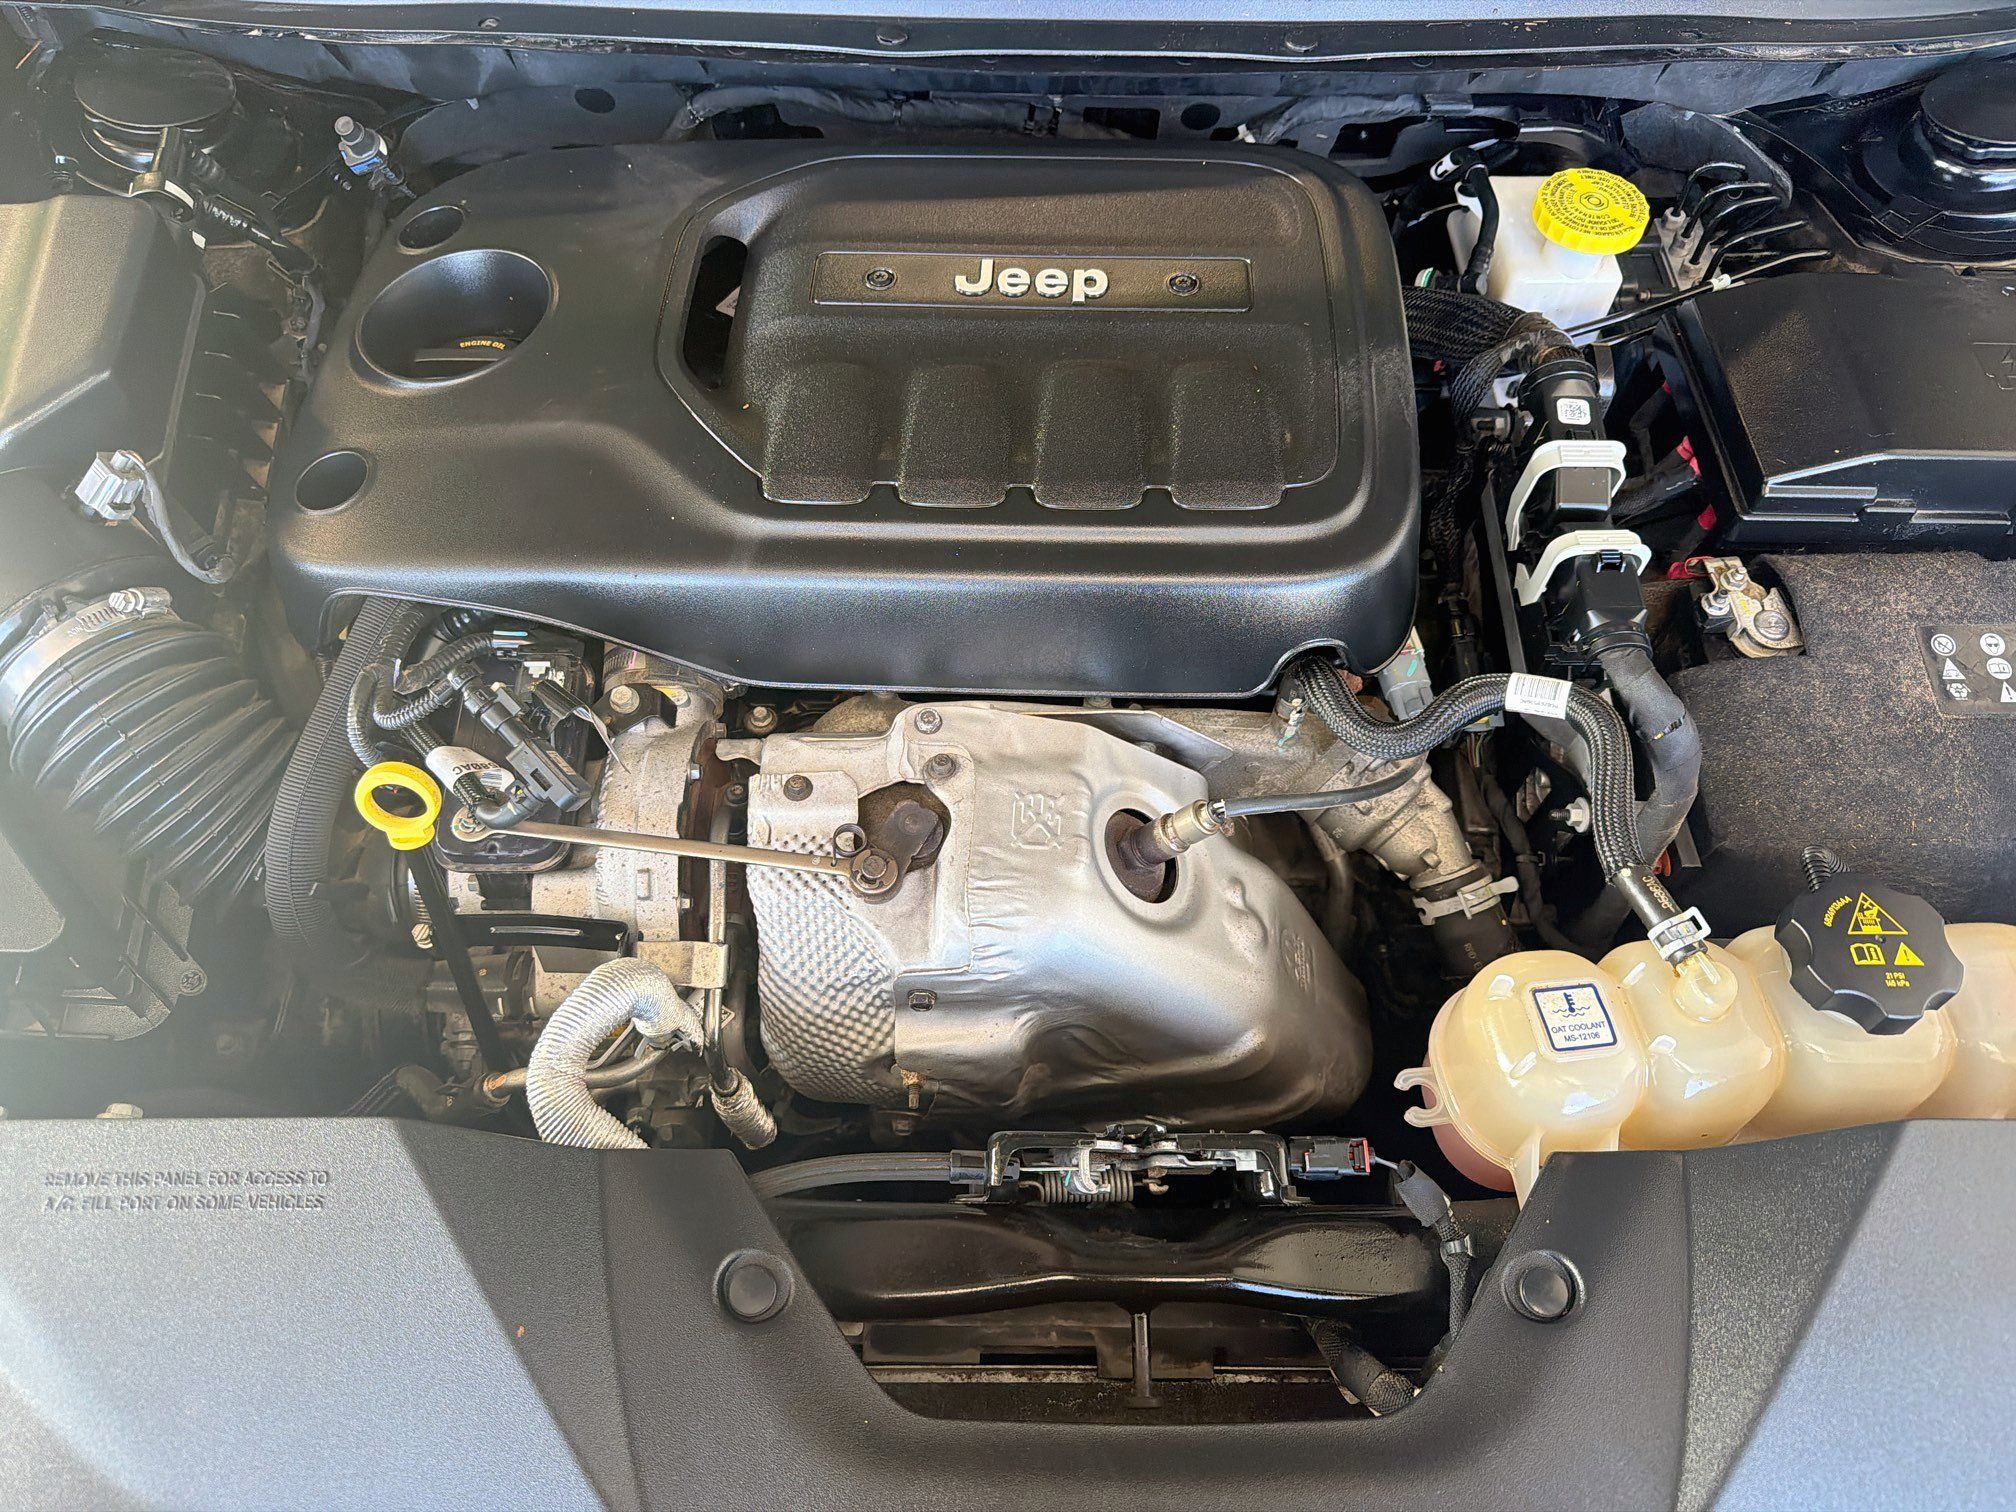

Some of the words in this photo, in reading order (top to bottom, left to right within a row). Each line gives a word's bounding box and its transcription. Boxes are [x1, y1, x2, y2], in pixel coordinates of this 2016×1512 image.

[954, 258, 1109, 305] Jeep
[460, 340, 491, 348] ENGINE
[491, 341, 506, 350] OIL
[1893, 972, 1905, 980] PSI
[1551, 1026, 1567, 1034] OAT
[1568, 1020, 1606, 1032] COOLANT
[1563, 1032, 1601, 1043] MS-12106
[44, 1171, 110, 1187] REMOVE
[114, 1170, 151, 1187] THIS
[153, 1170, 203, 1187] PANEL
[207, 1170, 240, 1186] FOR
[243, 1170, 305, 1186] ACCESS
[308, 1170, 329, 1186] TO
[81, 1195, 115, 1211] FILL
[118, 1195, 162, 1211] PORT
[165, 1195, 193, 1210] ON
[195, 1194, 242, 1210] SOME
[247, 1194, 326, 1211] VEHICLES
